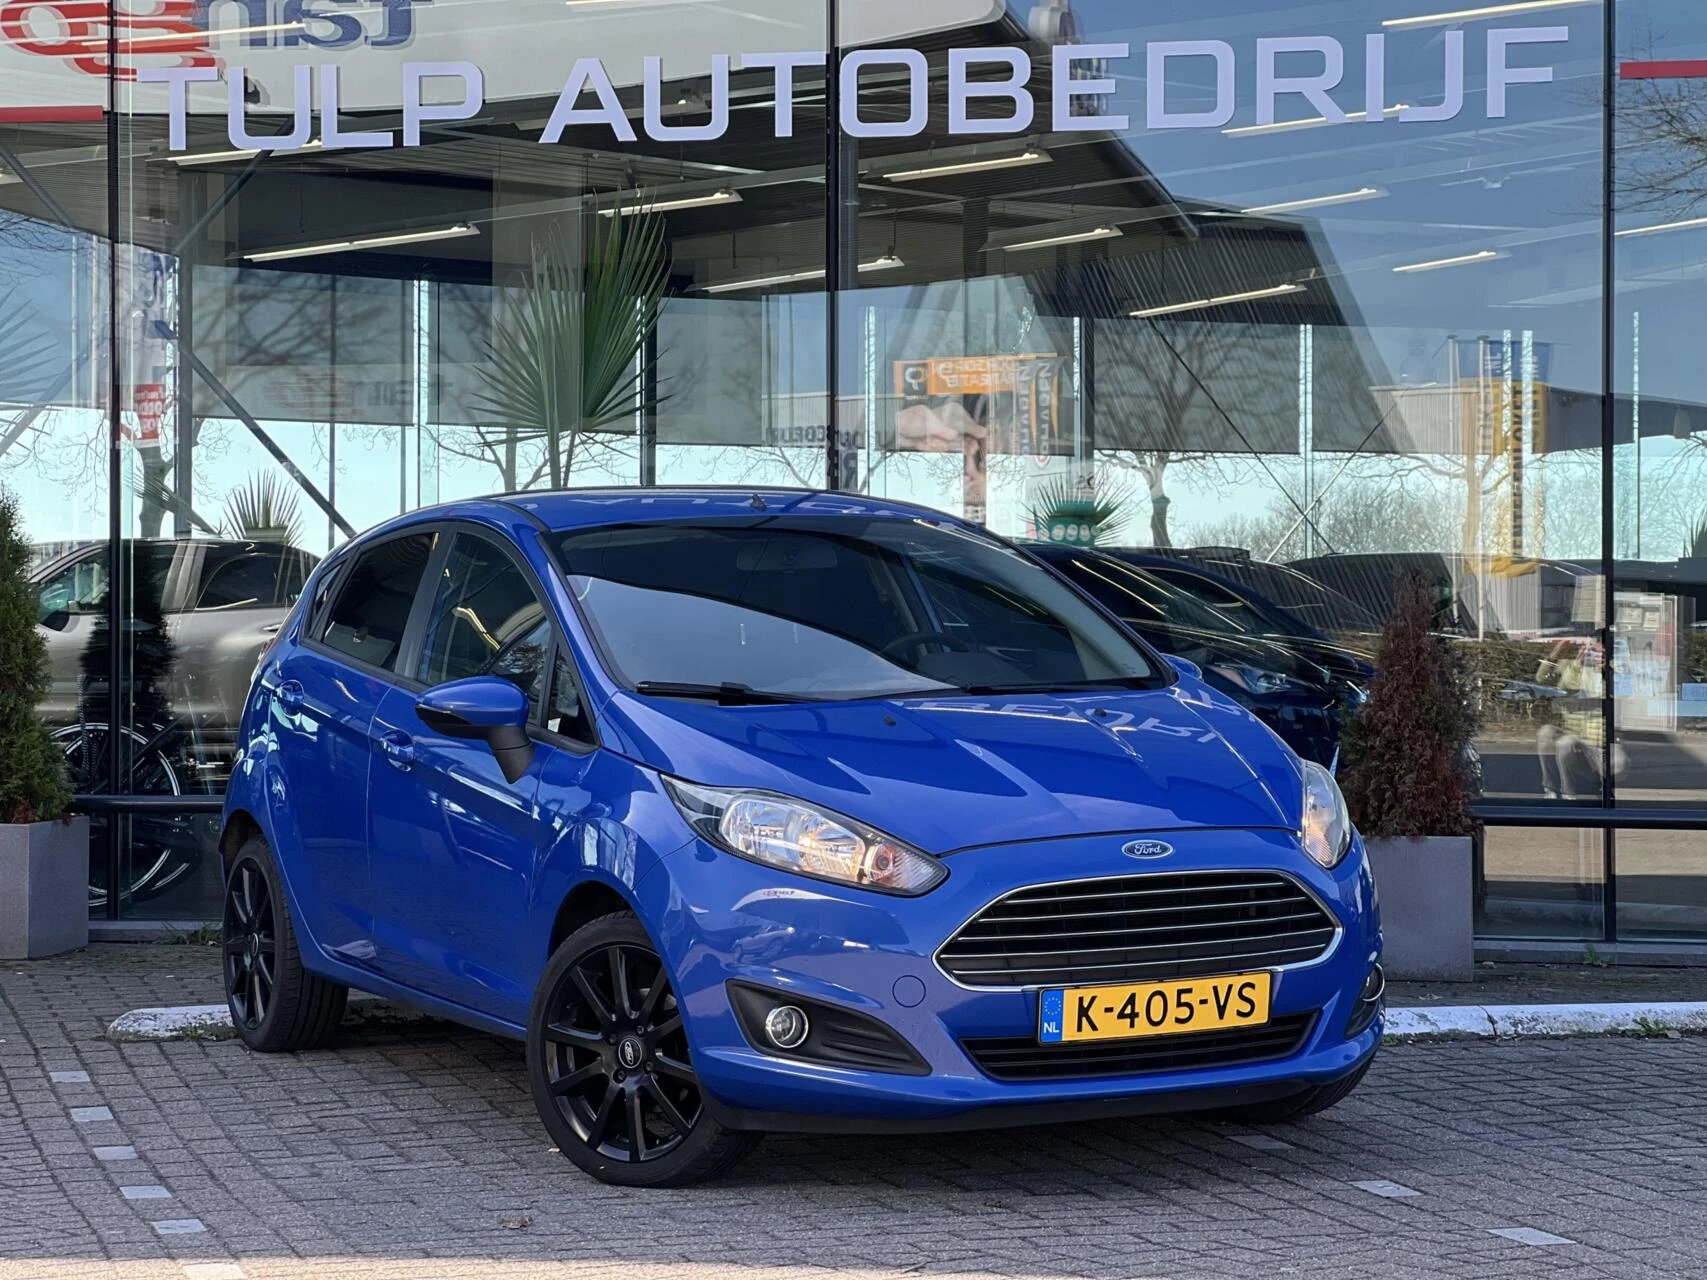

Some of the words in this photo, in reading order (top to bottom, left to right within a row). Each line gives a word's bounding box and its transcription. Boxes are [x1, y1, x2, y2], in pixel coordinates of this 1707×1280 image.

[137, 61, 484, 151] TULP
[539, 26, 1569, 143] AUTOBEDRIJF
[1133, 843, 1162, 855] Ford
[1076, 981, 1256, 1033] K-405-VS
[1043, 1021, 1060, 1034] NL
